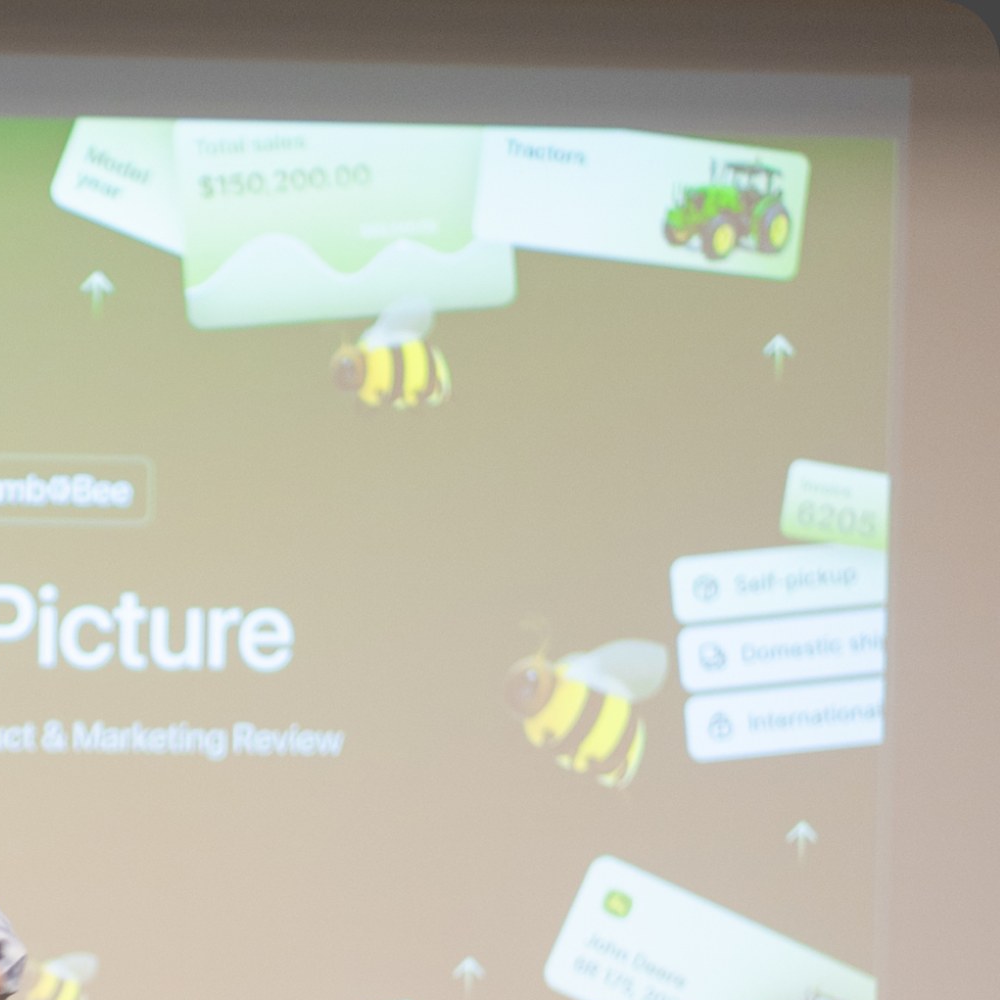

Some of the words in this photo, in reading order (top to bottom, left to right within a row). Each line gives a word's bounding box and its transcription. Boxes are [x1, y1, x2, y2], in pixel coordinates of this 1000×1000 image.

[196, 137, 246, 156] Total
[251, 134, 308, 152] sales
[506, 138, 589, 168] Tractors
[85, 145, 151, 185] Model
[77, 173, 123, 200] year
[797, 500, 877, 538] 6205
[734, 566, 857, 596] Self-pickup
[741, 636, 841, 664] Domestic
[41, 718, 67, 753] &
[72, 718, 229, 761] Marketing
[232, 721, 346, 757] Review
[584, 932, 630, 961] John
[631, 951, 687, 989] Deere
